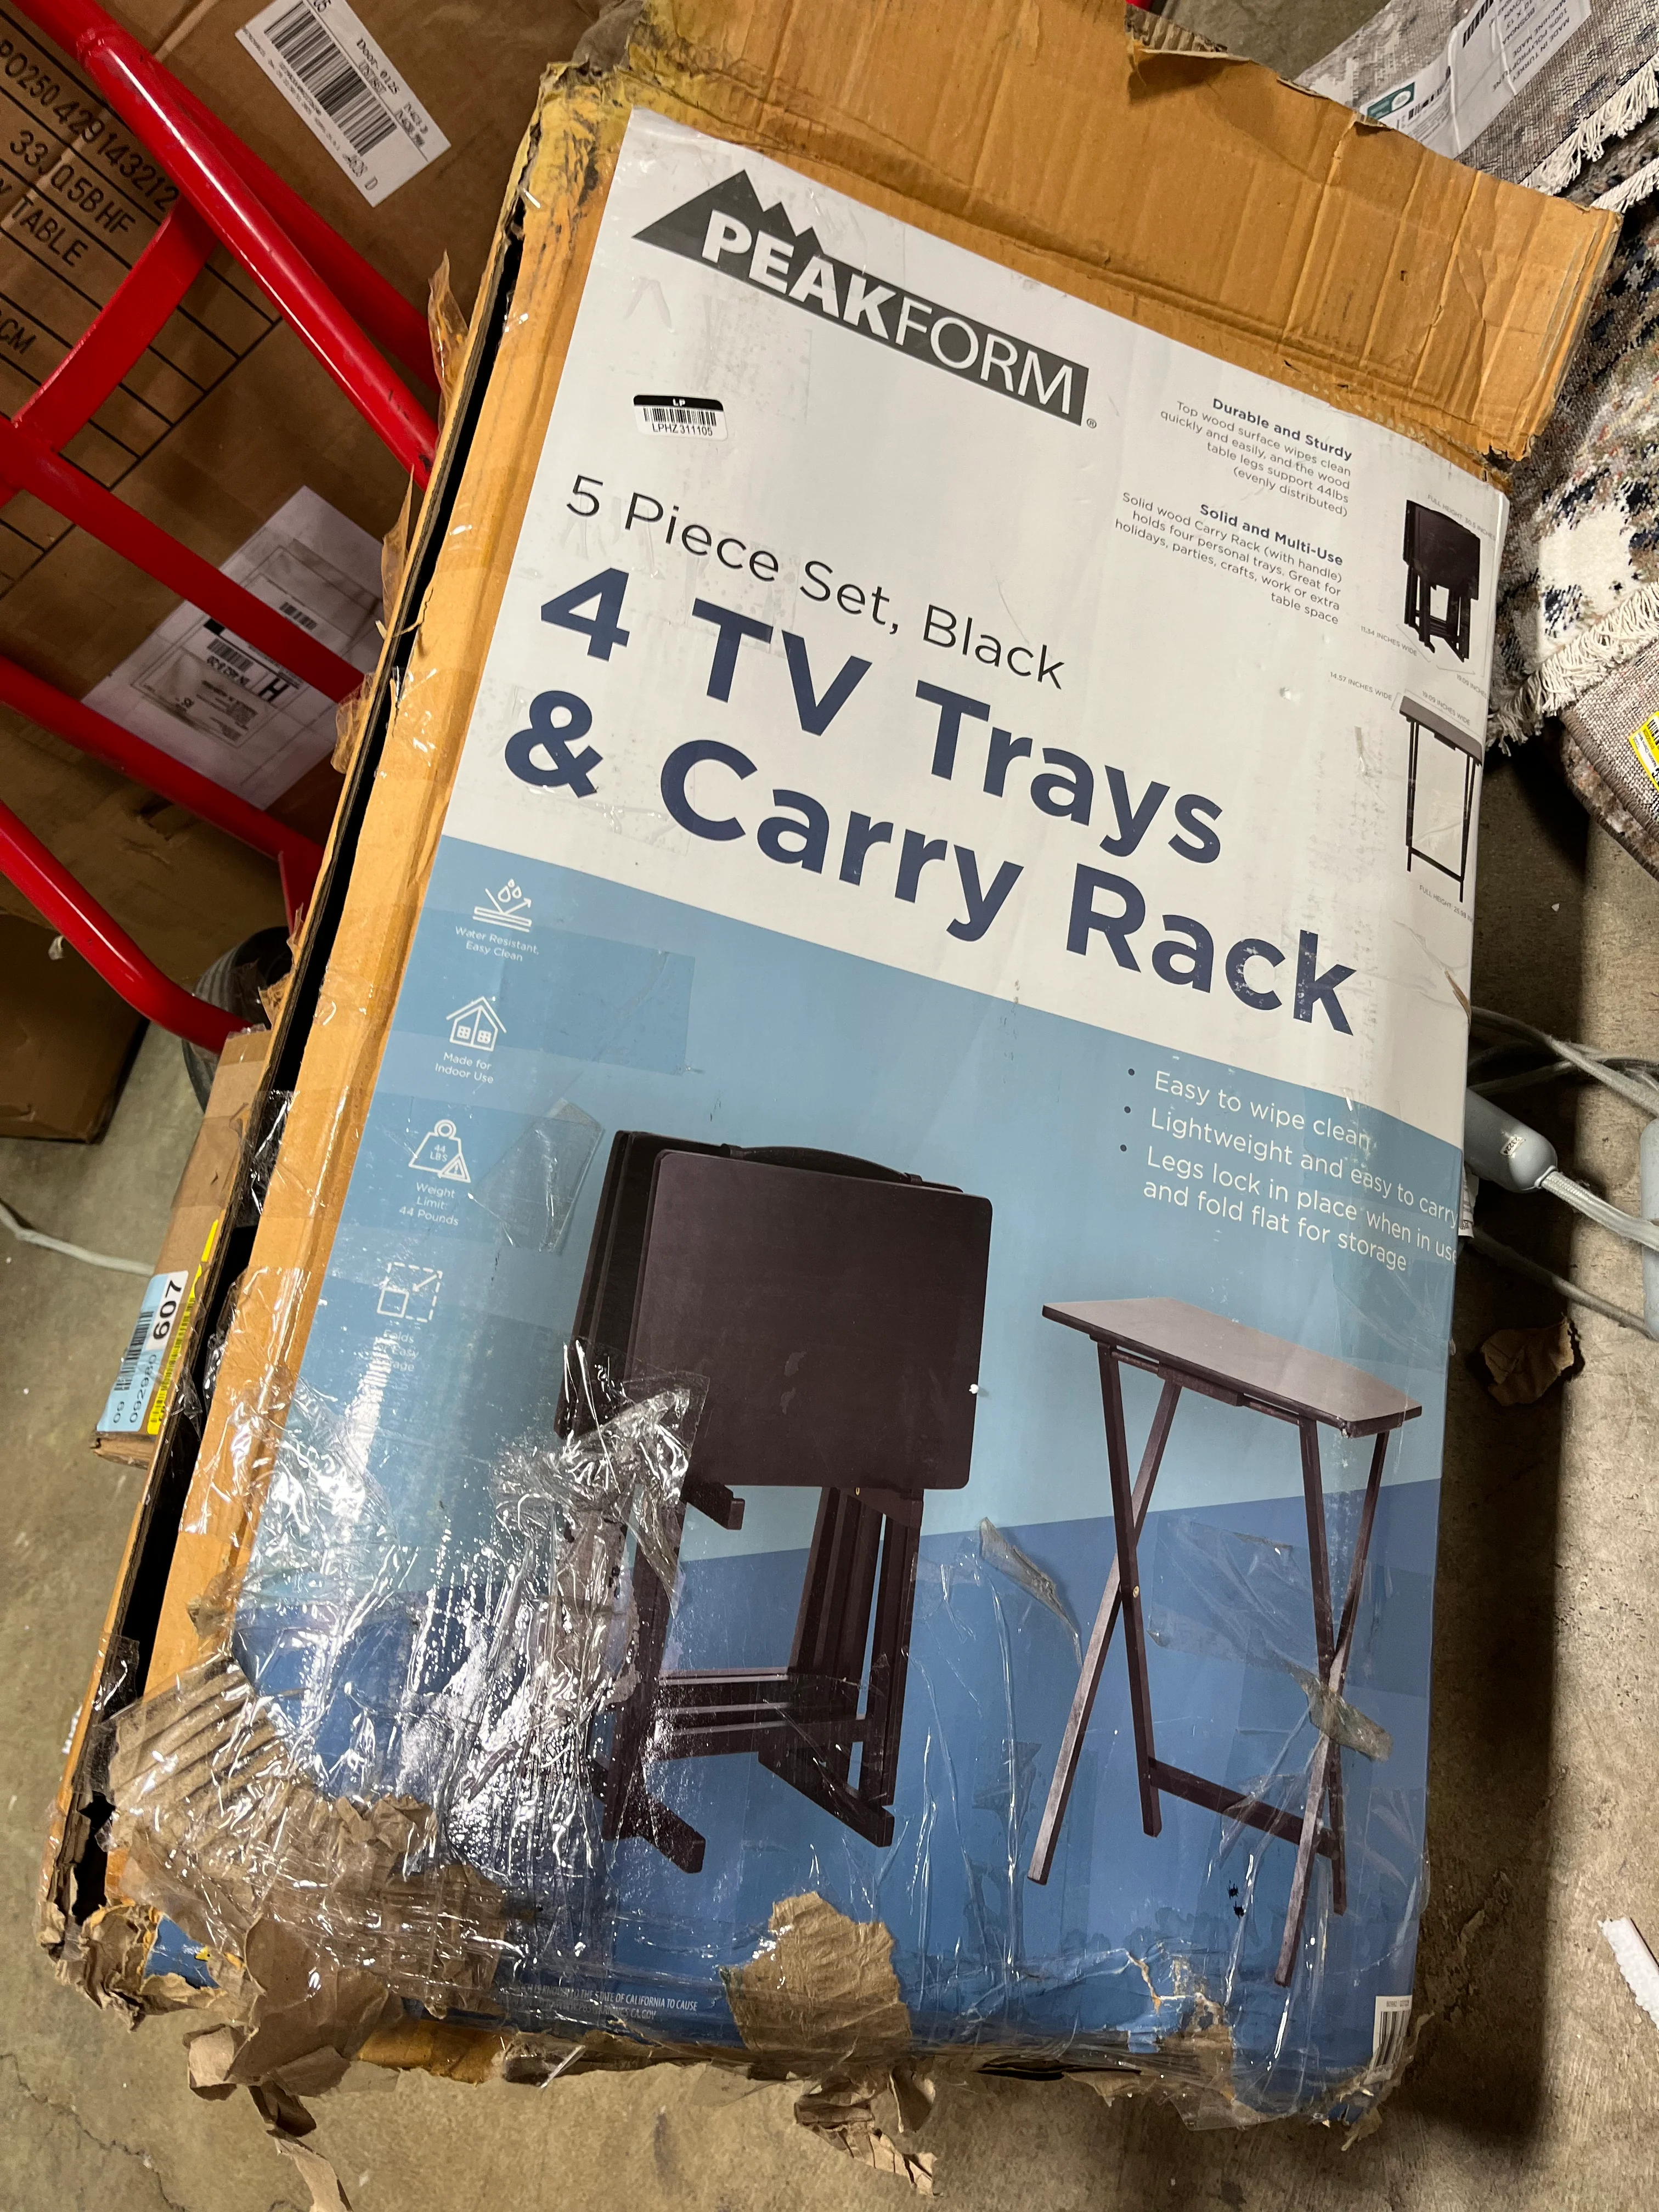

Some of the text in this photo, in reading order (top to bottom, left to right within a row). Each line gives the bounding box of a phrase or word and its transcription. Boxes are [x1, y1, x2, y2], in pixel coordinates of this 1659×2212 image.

[1513, 34, 1533, 58] MADE
[1513, 16, 1570, 82] MADE IN TURKEY
[12, 196, 88, 268] TABLE
[0, 309, 36, 354] CM
[701, 208, 1074, 416] PEAKFORM
[673, 398, 686, 407] LP
[1160, 410, 1350, 490] quickly and easily, and the wood
[1176, 401, 1351, 476] Top wood surface wipes clean
[1212, 398, 1352, 461] Durable and Sturdy
[1207, 442, 1349, 503] table legs support 44lbs
[1233, 466, 1348, 517] (evenly distributed)
[1427, 494, 1441, 507] FULL
[1122, 492, 1342, 583] Solid wood Carry Rack (with handle)
[1132, 510, 1341, 596] holds four personal trays. Great for
[1199, 504, 1344, 566] Solid and Multi-Use
[567, 474, 1065, 691] 5 Piece Set, Black
[1115, 518, 1340, 611] holidays, parties, crafts, work or extra
[1271, 592, 1339, 624] table space
[1361, 625, 1418, 656] 11.34 INCHES WIDE
[258, 677, 289, 704] H
[1330, 672, 1392, 701] 14.57 INCHES WIDE
[1422, 690, 1471, 726] 19.09 INCHES WIDE
[1457, 673, 1487, 699] 19.09 INCHES
[540, 567, 1223, 866] 4 TV Trays
[504, 689, 1357, 1037] & Carry Rack
[1419, 884, 1432, 898] FULL
[455, 926, 540, 955] Water Resistant,
[466, 940, 523, 962] Easy Clean
[435, 1062, 494, 1084] Indoor Use
[443, 1052, 492, 1070] Made for
[1155, 1070, 1371, 1149] Easy to wipe clean
[430, 1150, 448, 1163] LBS
[433, 1144, 446, 1153] 44
[1151, 1107, 1458, 1229] Lightweight and easy to carry
[416, 1182, 455, 1199] Weight
[1147, 1146, 1457, 1265] Legs lock in place when in use
[399, 1205, 460, 1227] 44 Pounds
[1143, 1180, 1407, 1272] and fold flat for storage
[153, 1279, 182, 1340] 607
[392, 1344, 419, 1361] Easy
[129, 1353, 157, 1423] 092980
[113, 1400, 125, 1423] 09
[579, 1989, 594, 2000] THE
[615, 1993, 626, 2003] OF
[625, 1994, 666, 2008] CALIFORNIA
[667, 1997, 676, 2009] TO
[676, 1999, 698, 2012] CAUSE
